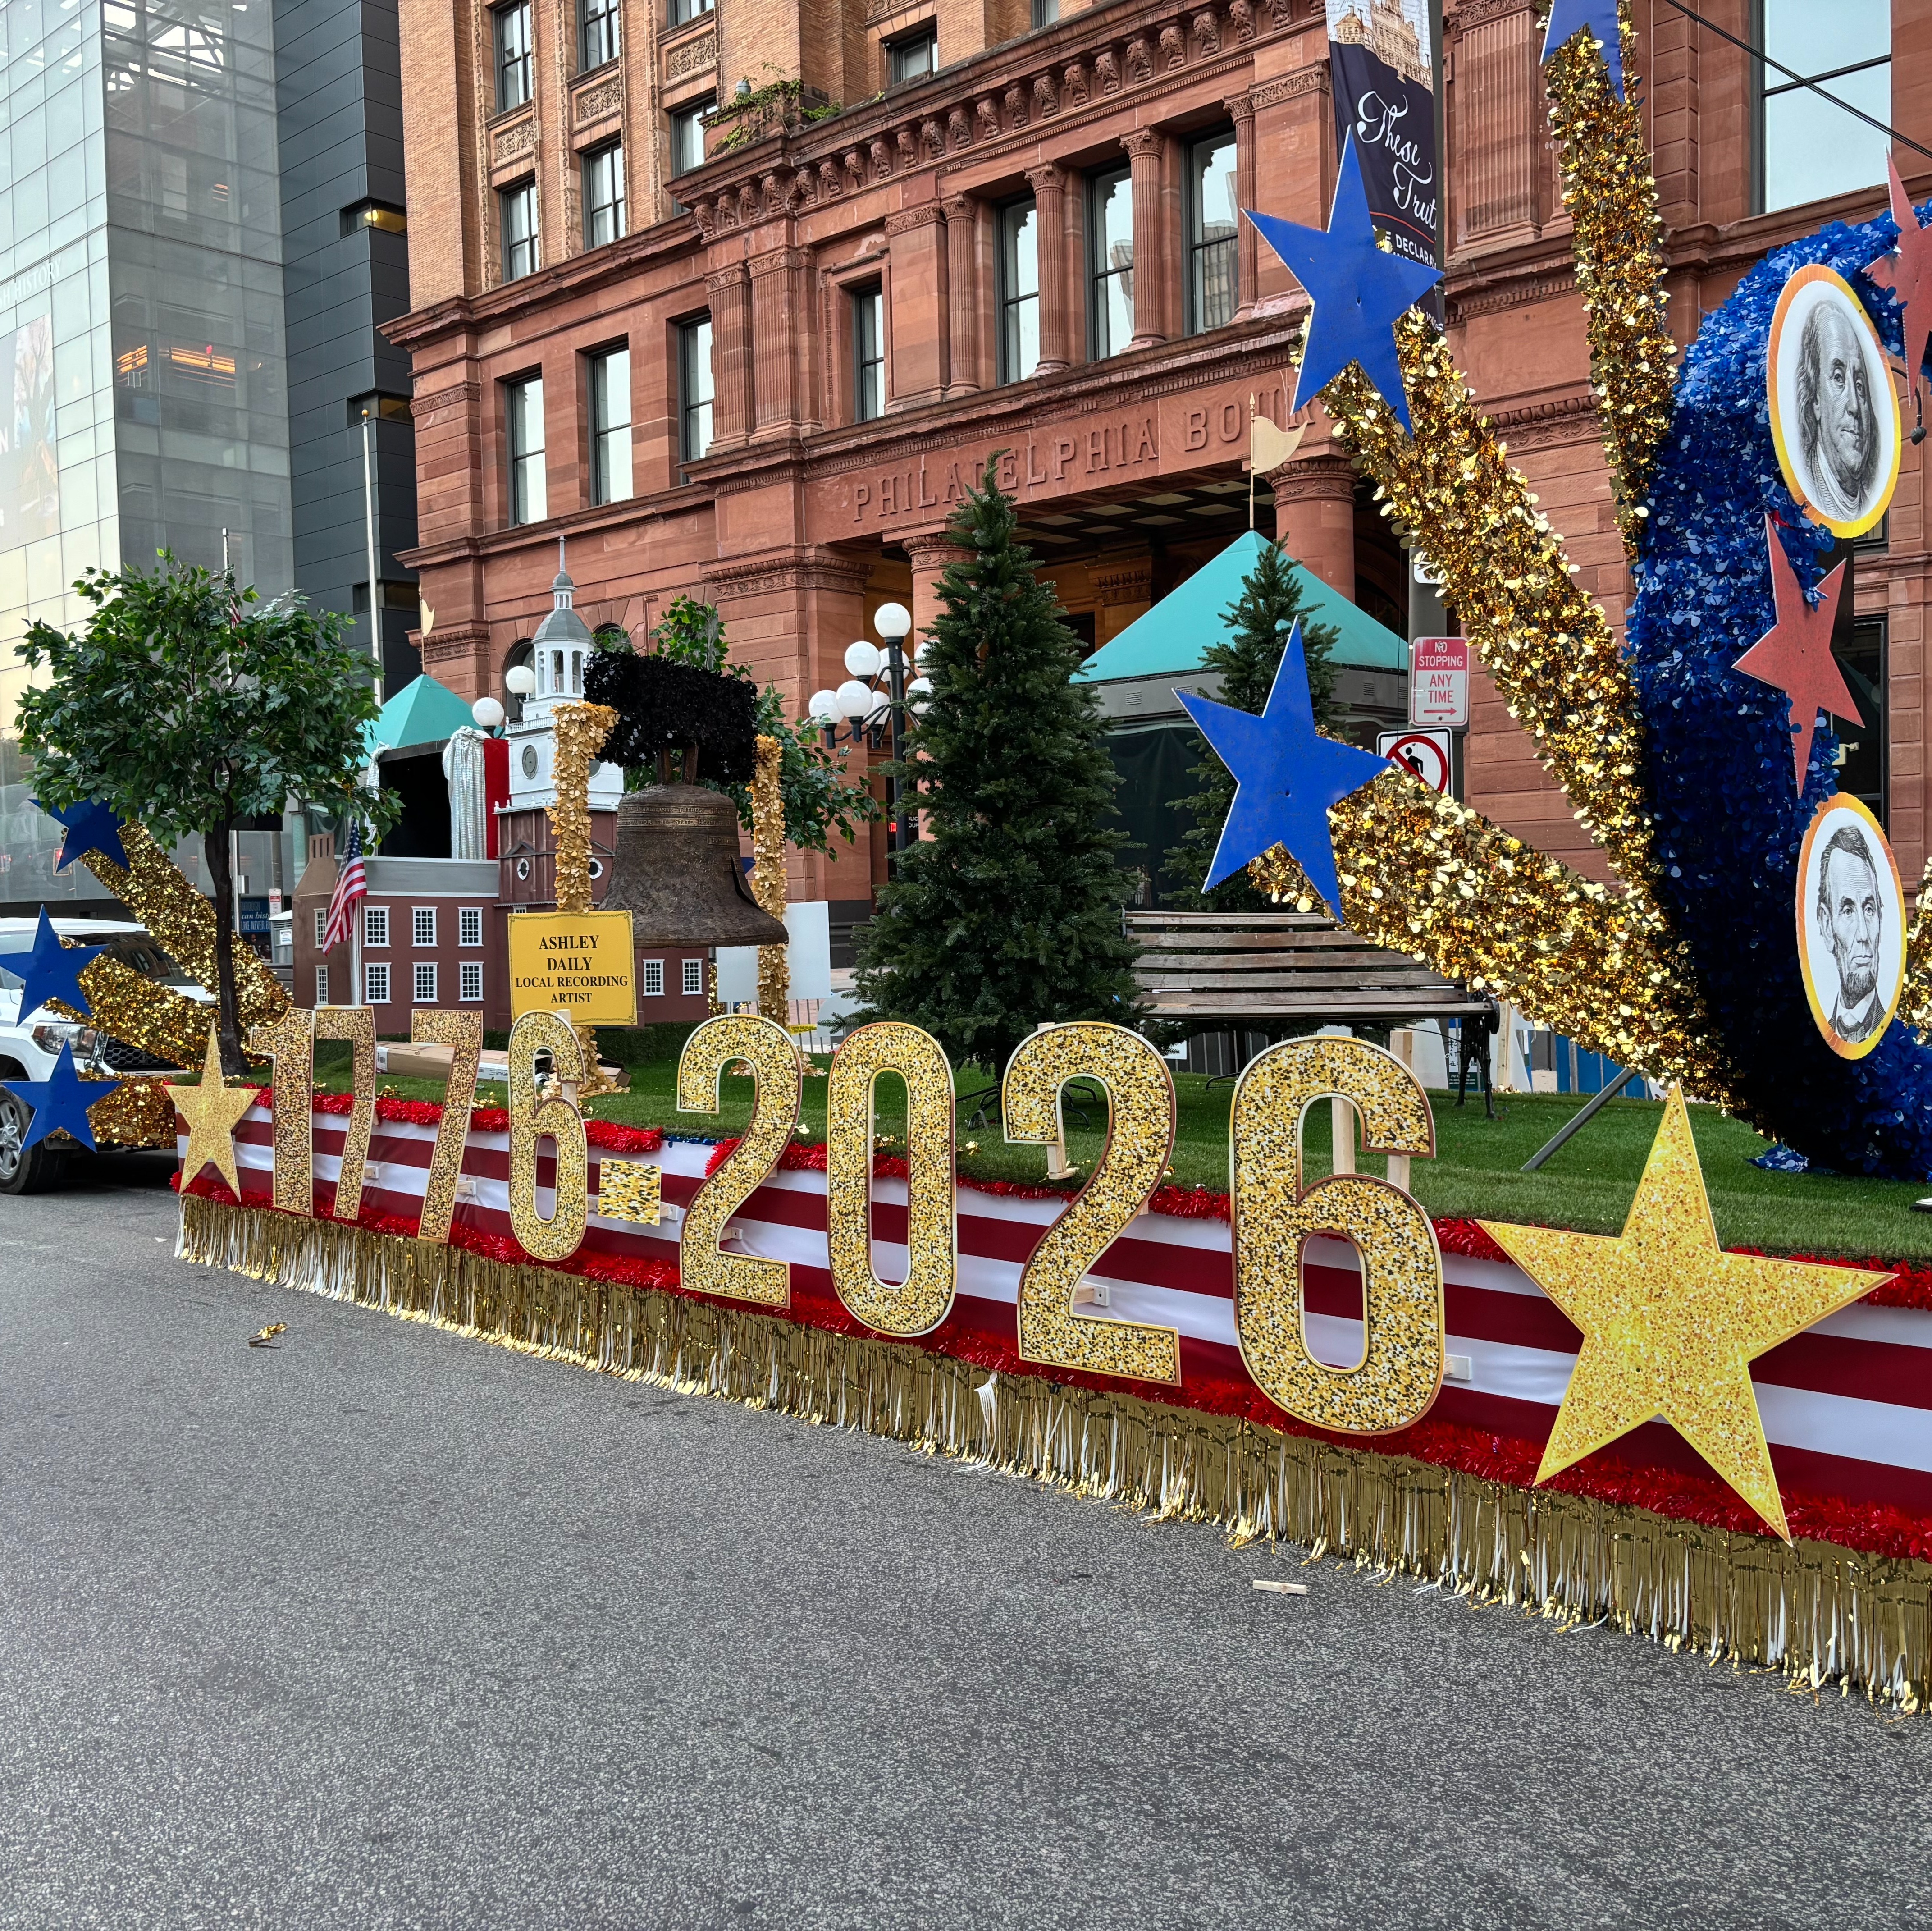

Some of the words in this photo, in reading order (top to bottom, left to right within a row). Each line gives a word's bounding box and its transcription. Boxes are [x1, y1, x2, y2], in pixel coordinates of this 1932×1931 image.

[1357, 91, 1420, 166] These
[1393, 161, 1437, 231] Trut
[1395, 234, 1436, 270] DECLARA
[14, 256, 61, 301] HISTORY
[854, 418, 1159, 522] PHILADELPHIA
[1435, 642, 1448, 653] NO
[1419, 656, 1463, 667] STOPPING
[1430, 674, 1452, 687] ANY
[1428, 690, 1454, 703] TIME
[539, 935, 599, 950] ASHLEY
[547, 957, 593, 971] DAILY
[516, 977, 554, 988] LOCAL
[557, 975, 628, 987] RECORDING
[550, 993, 592, 1003] ARTIST
[250, 1005, 1444, 1436] 1776-2026
